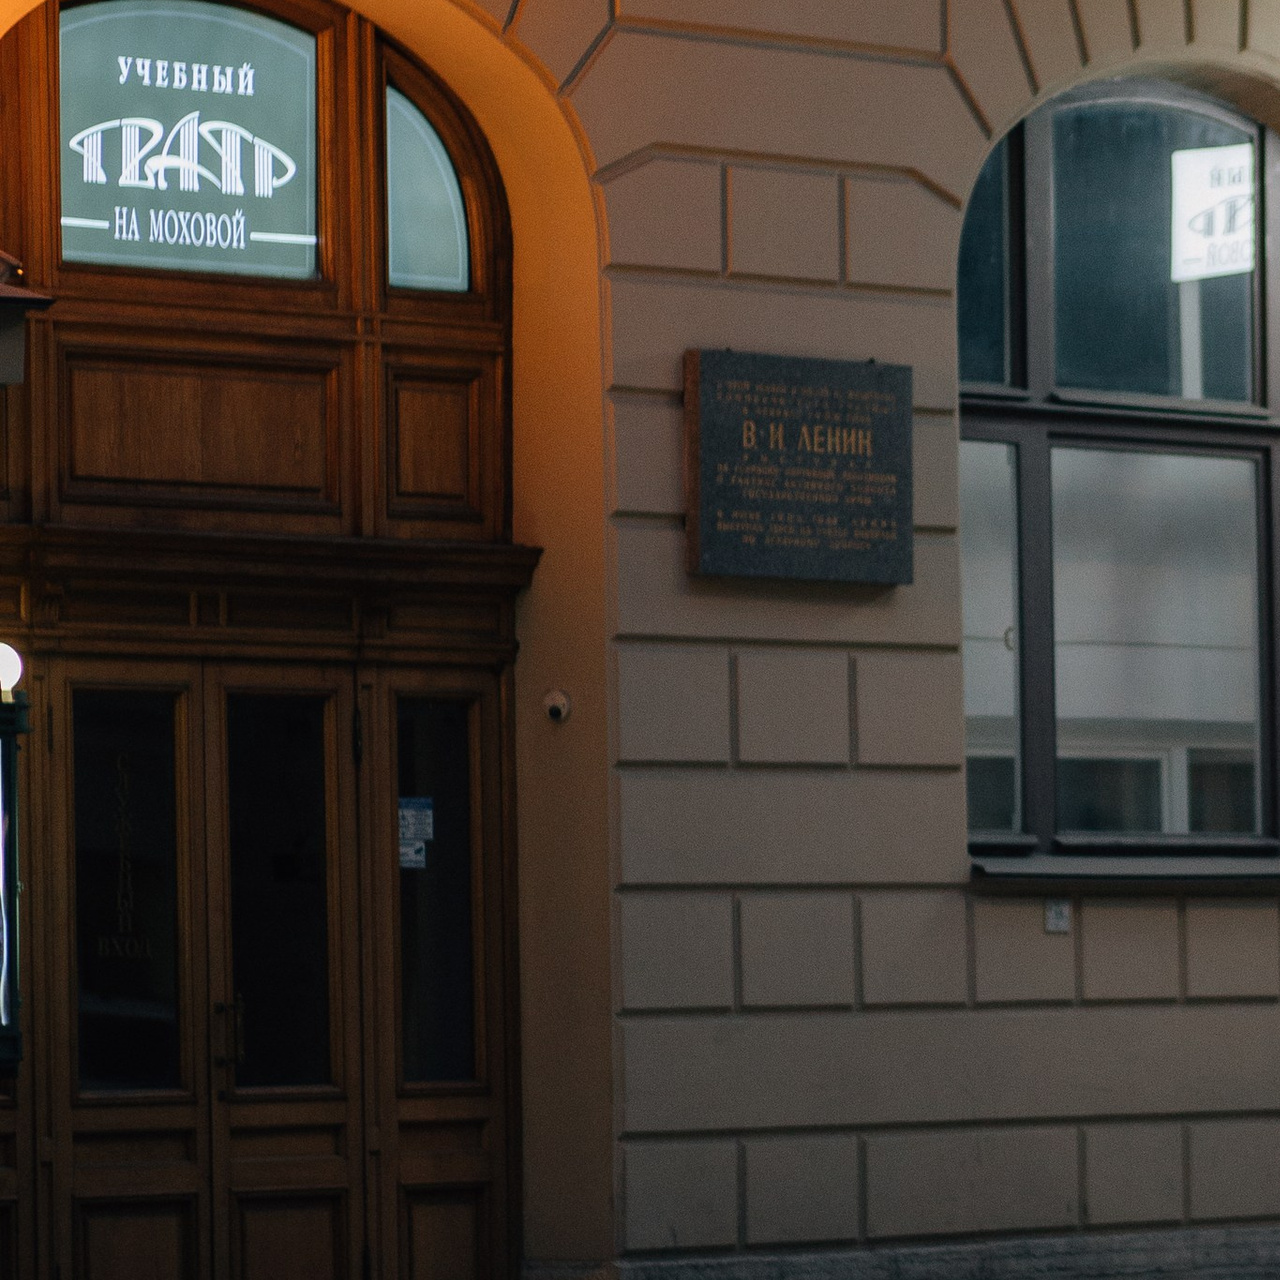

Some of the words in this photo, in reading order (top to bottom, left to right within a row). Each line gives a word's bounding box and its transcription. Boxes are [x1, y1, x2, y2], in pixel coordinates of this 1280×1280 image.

[117, 55, 255, 96] УЧЕБНЫЙ
[69, 110, 296, 199] ТЕАТР
[114, 206, 140, 242] НА
[149, 208, 246, 250] МОХОВОЙ
[797, 423, 873, 457] ЛЕНИН
